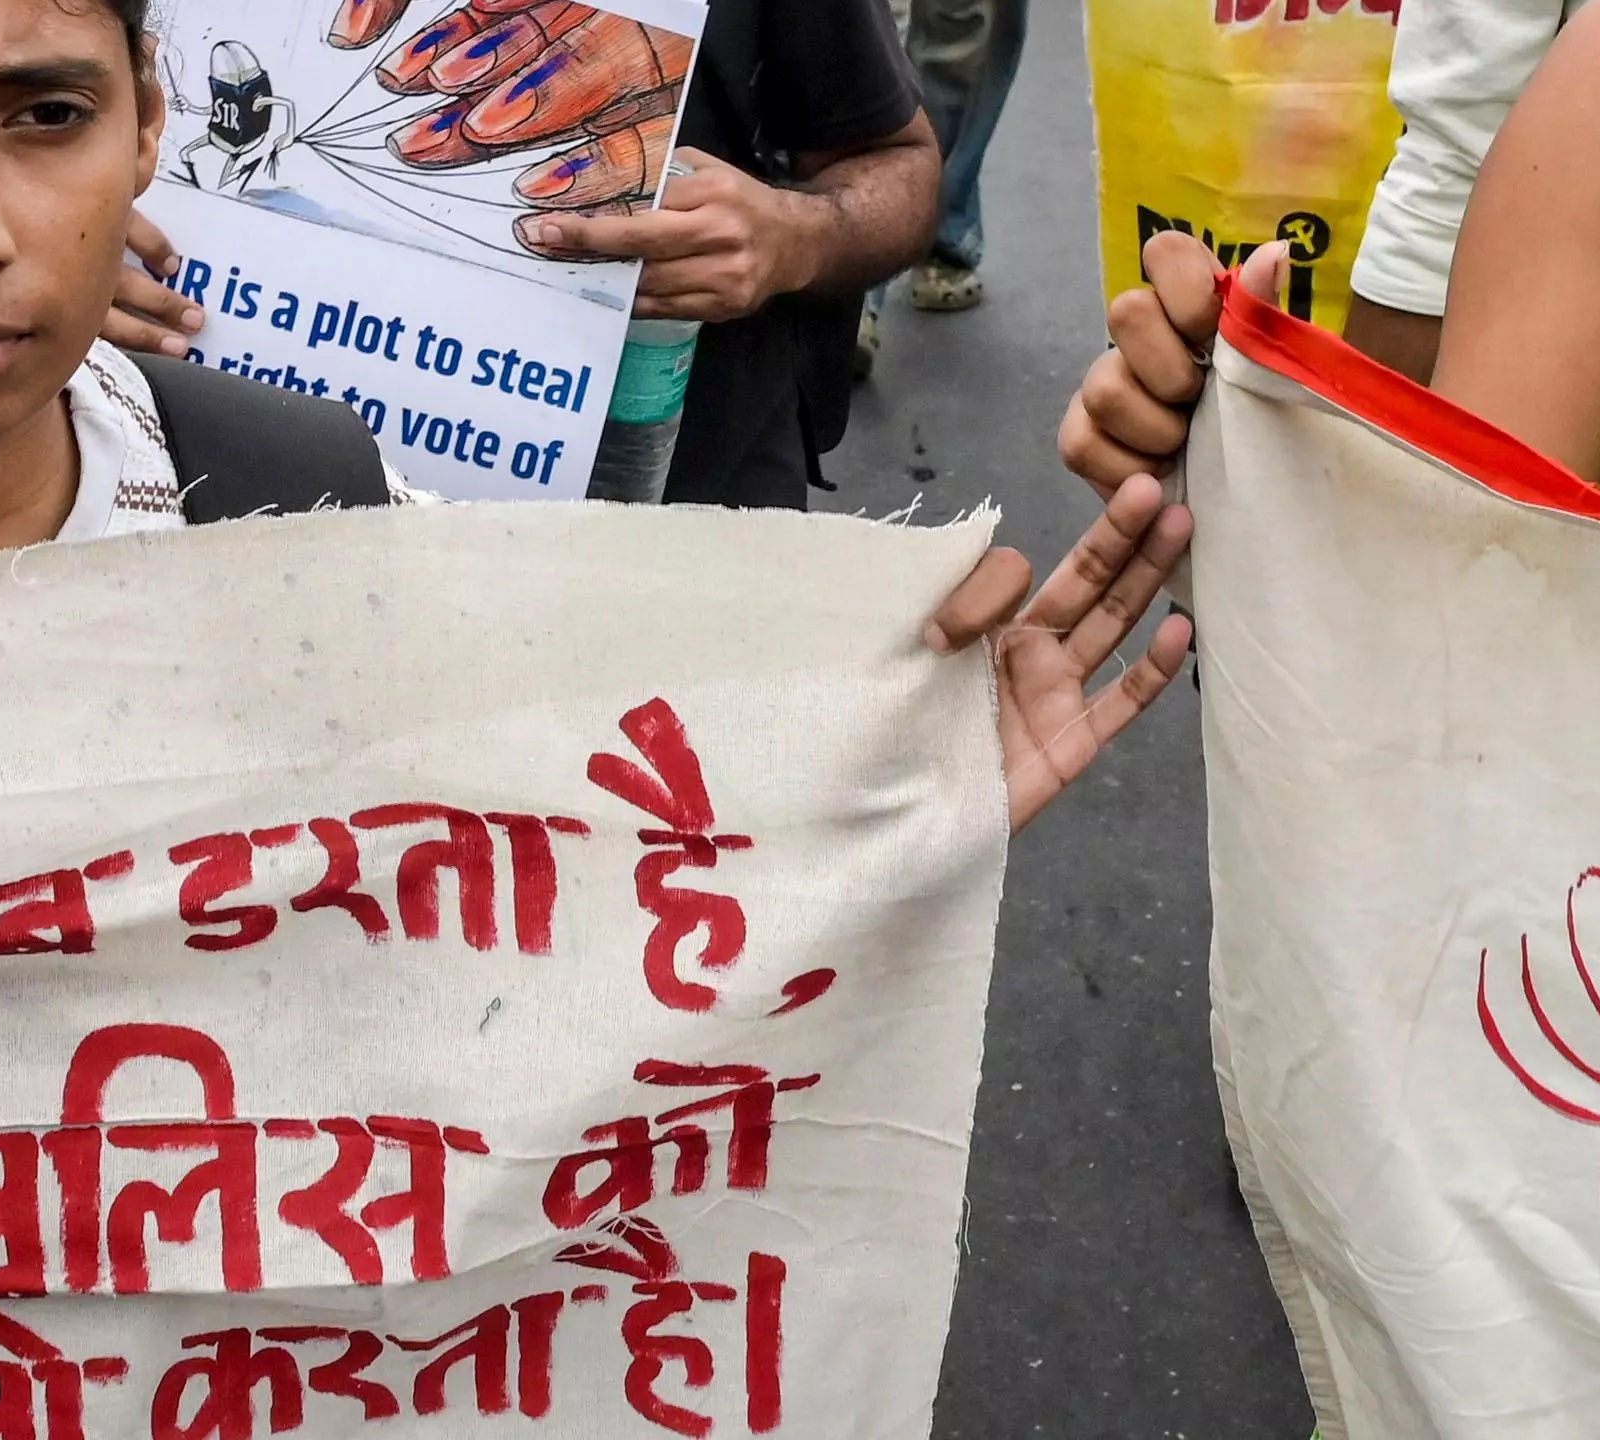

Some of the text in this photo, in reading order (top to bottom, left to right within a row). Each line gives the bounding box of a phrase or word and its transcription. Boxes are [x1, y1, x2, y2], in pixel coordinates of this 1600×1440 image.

[212, 97, 240, 131] SIR
[165, 256, 593, 413] IR is a plot to steal
[401, 406, 501, 470] vote
[511, 440, 566, 486] of
[169, 801, 591, 954] डरता
[147, 1282, 607, 1440] करता
